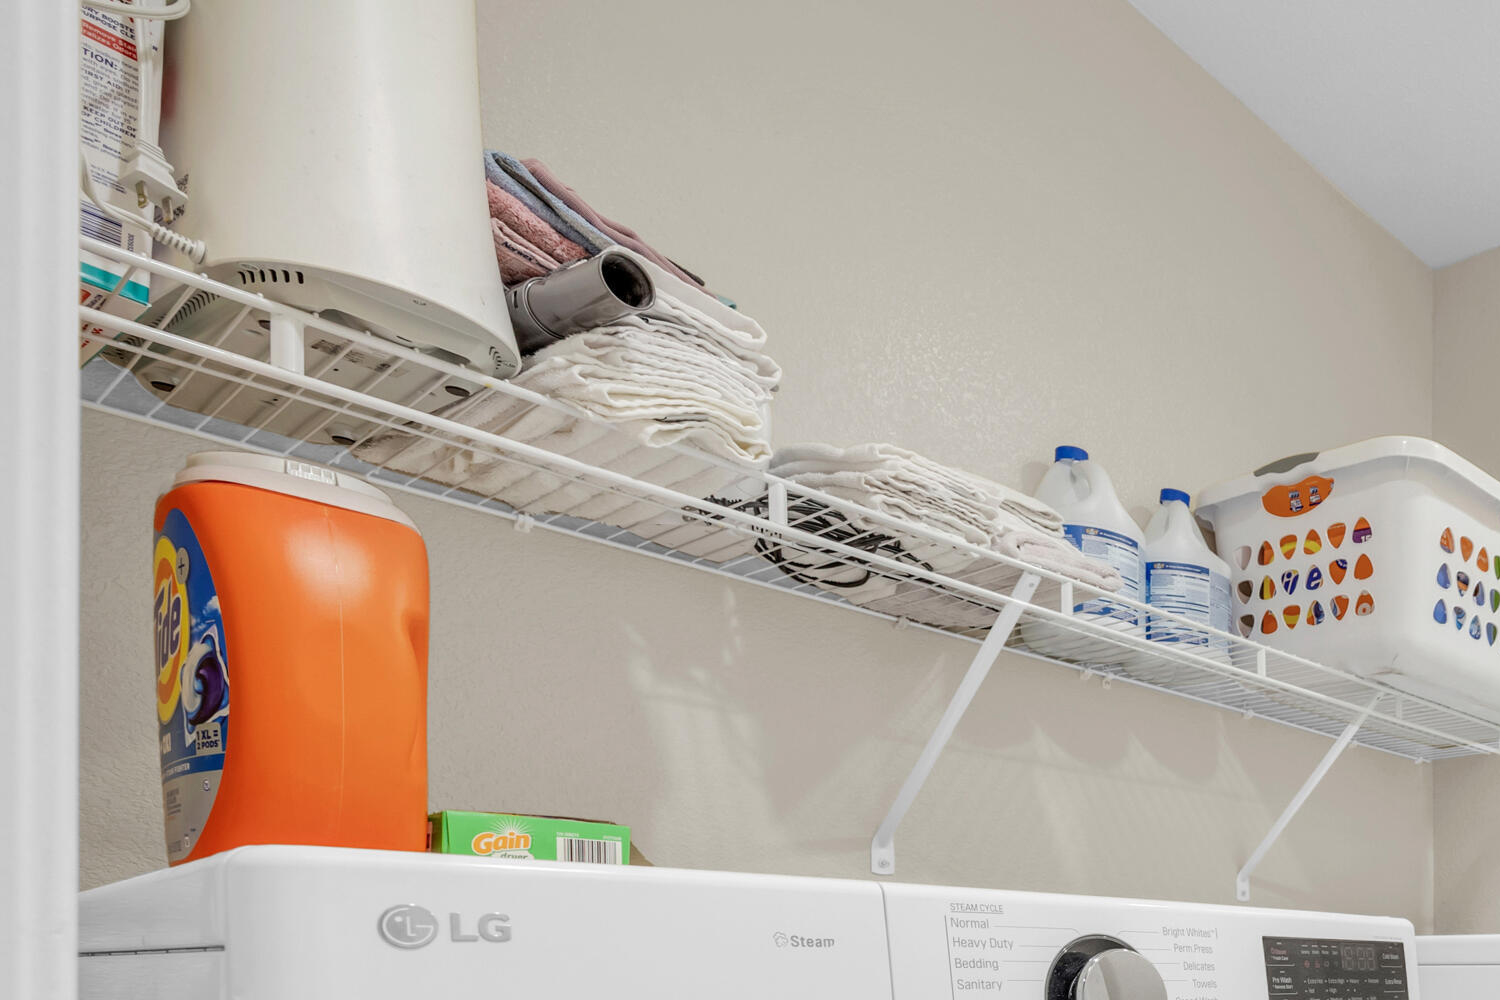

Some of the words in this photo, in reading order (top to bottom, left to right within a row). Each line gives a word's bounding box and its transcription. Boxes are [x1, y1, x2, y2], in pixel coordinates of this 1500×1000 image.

[82, 10, 118, 31] URPOSE
[101, 13, 136, 35] BOOSTE
[82, 47, 118, 70] TION:
[472, 832, 531, 855] Gain
[950, 902, 978, 912] STEAM
[979, 903, 1004, 913] CYCLE
[449, 912, 512, 943] LG
[950, 917, 990, 929] Normal
[1162, 926, 1185, 938] Bright
[790, 935, 835, 948] Steam
[952, 936, 987, 950] Heavy
[989, 937, 1014, 950] Duty
[954, 957, 1000, 971] Bedding
[1183, 961, 1216, 972] Delicates
[957, 978, 1003, 991] Sanitary
[1192, 978, 1218, 989] Towels
